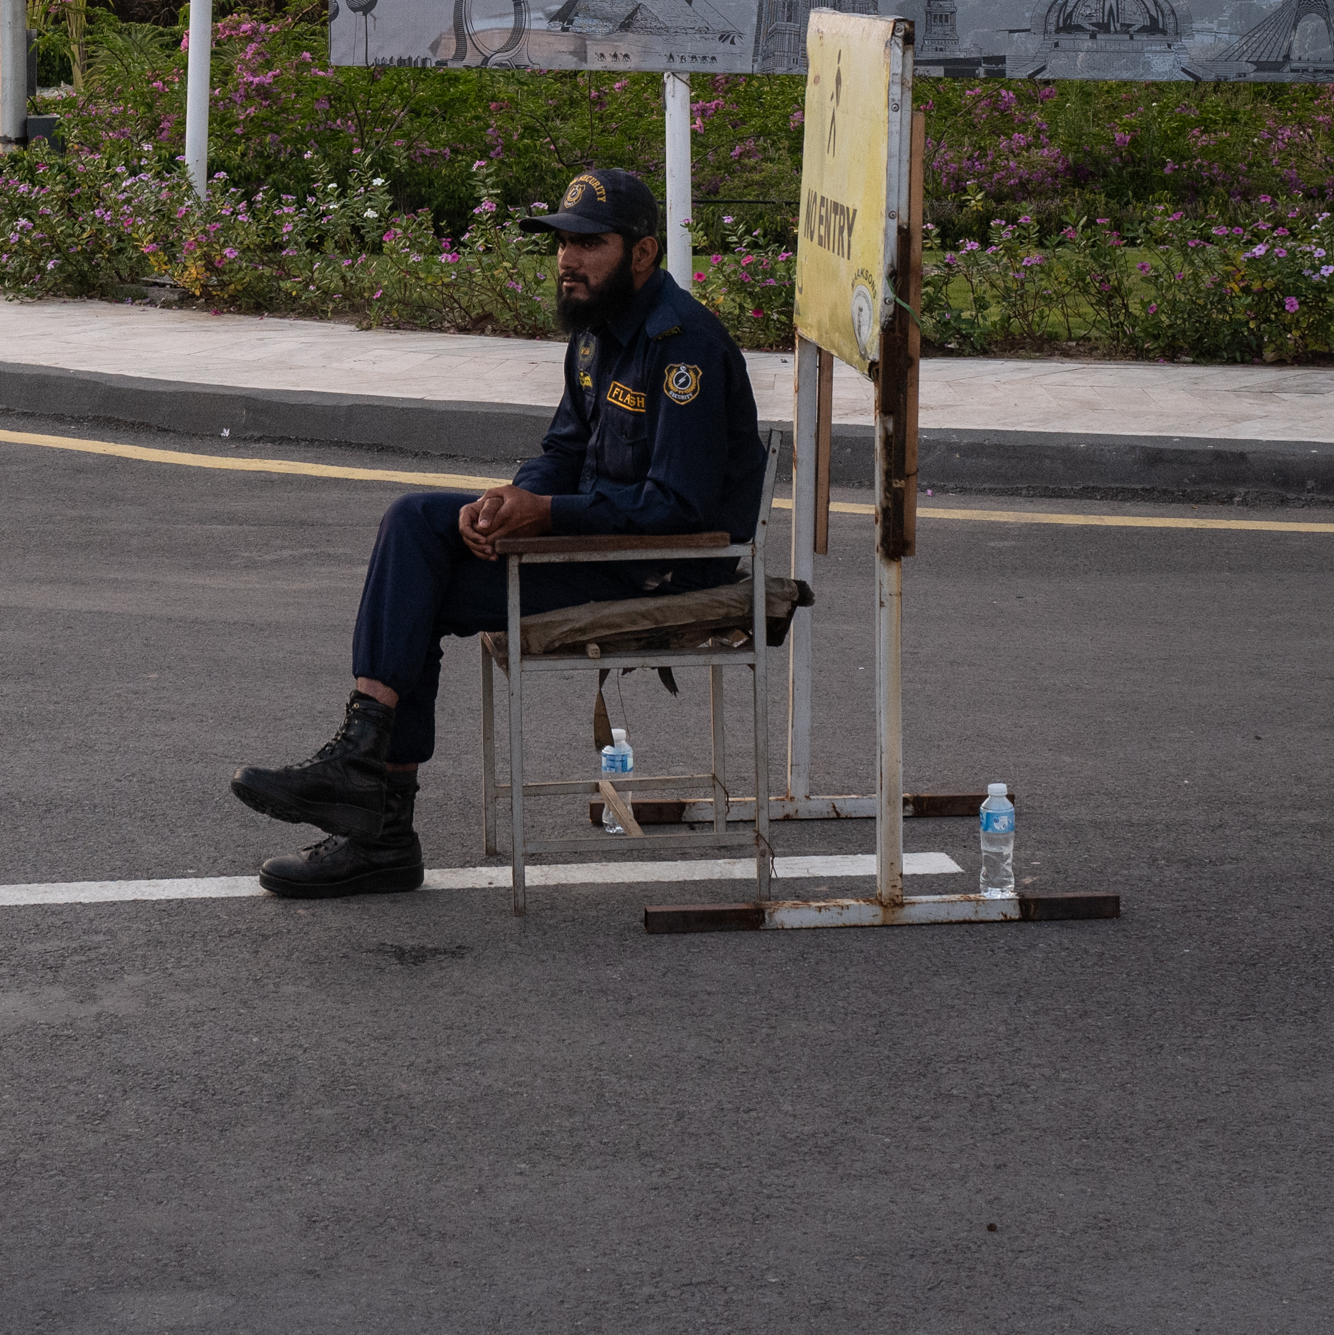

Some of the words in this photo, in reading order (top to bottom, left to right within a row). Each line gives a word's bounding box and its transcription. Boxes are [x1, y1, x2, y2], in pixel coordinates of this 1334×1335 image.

[803, 188, 817, 243] NO
[817, 195, 858, 261] ENTRY
[612, 387, 646, 408] FLASH
[668, 389, 694, 401] SECURITY
